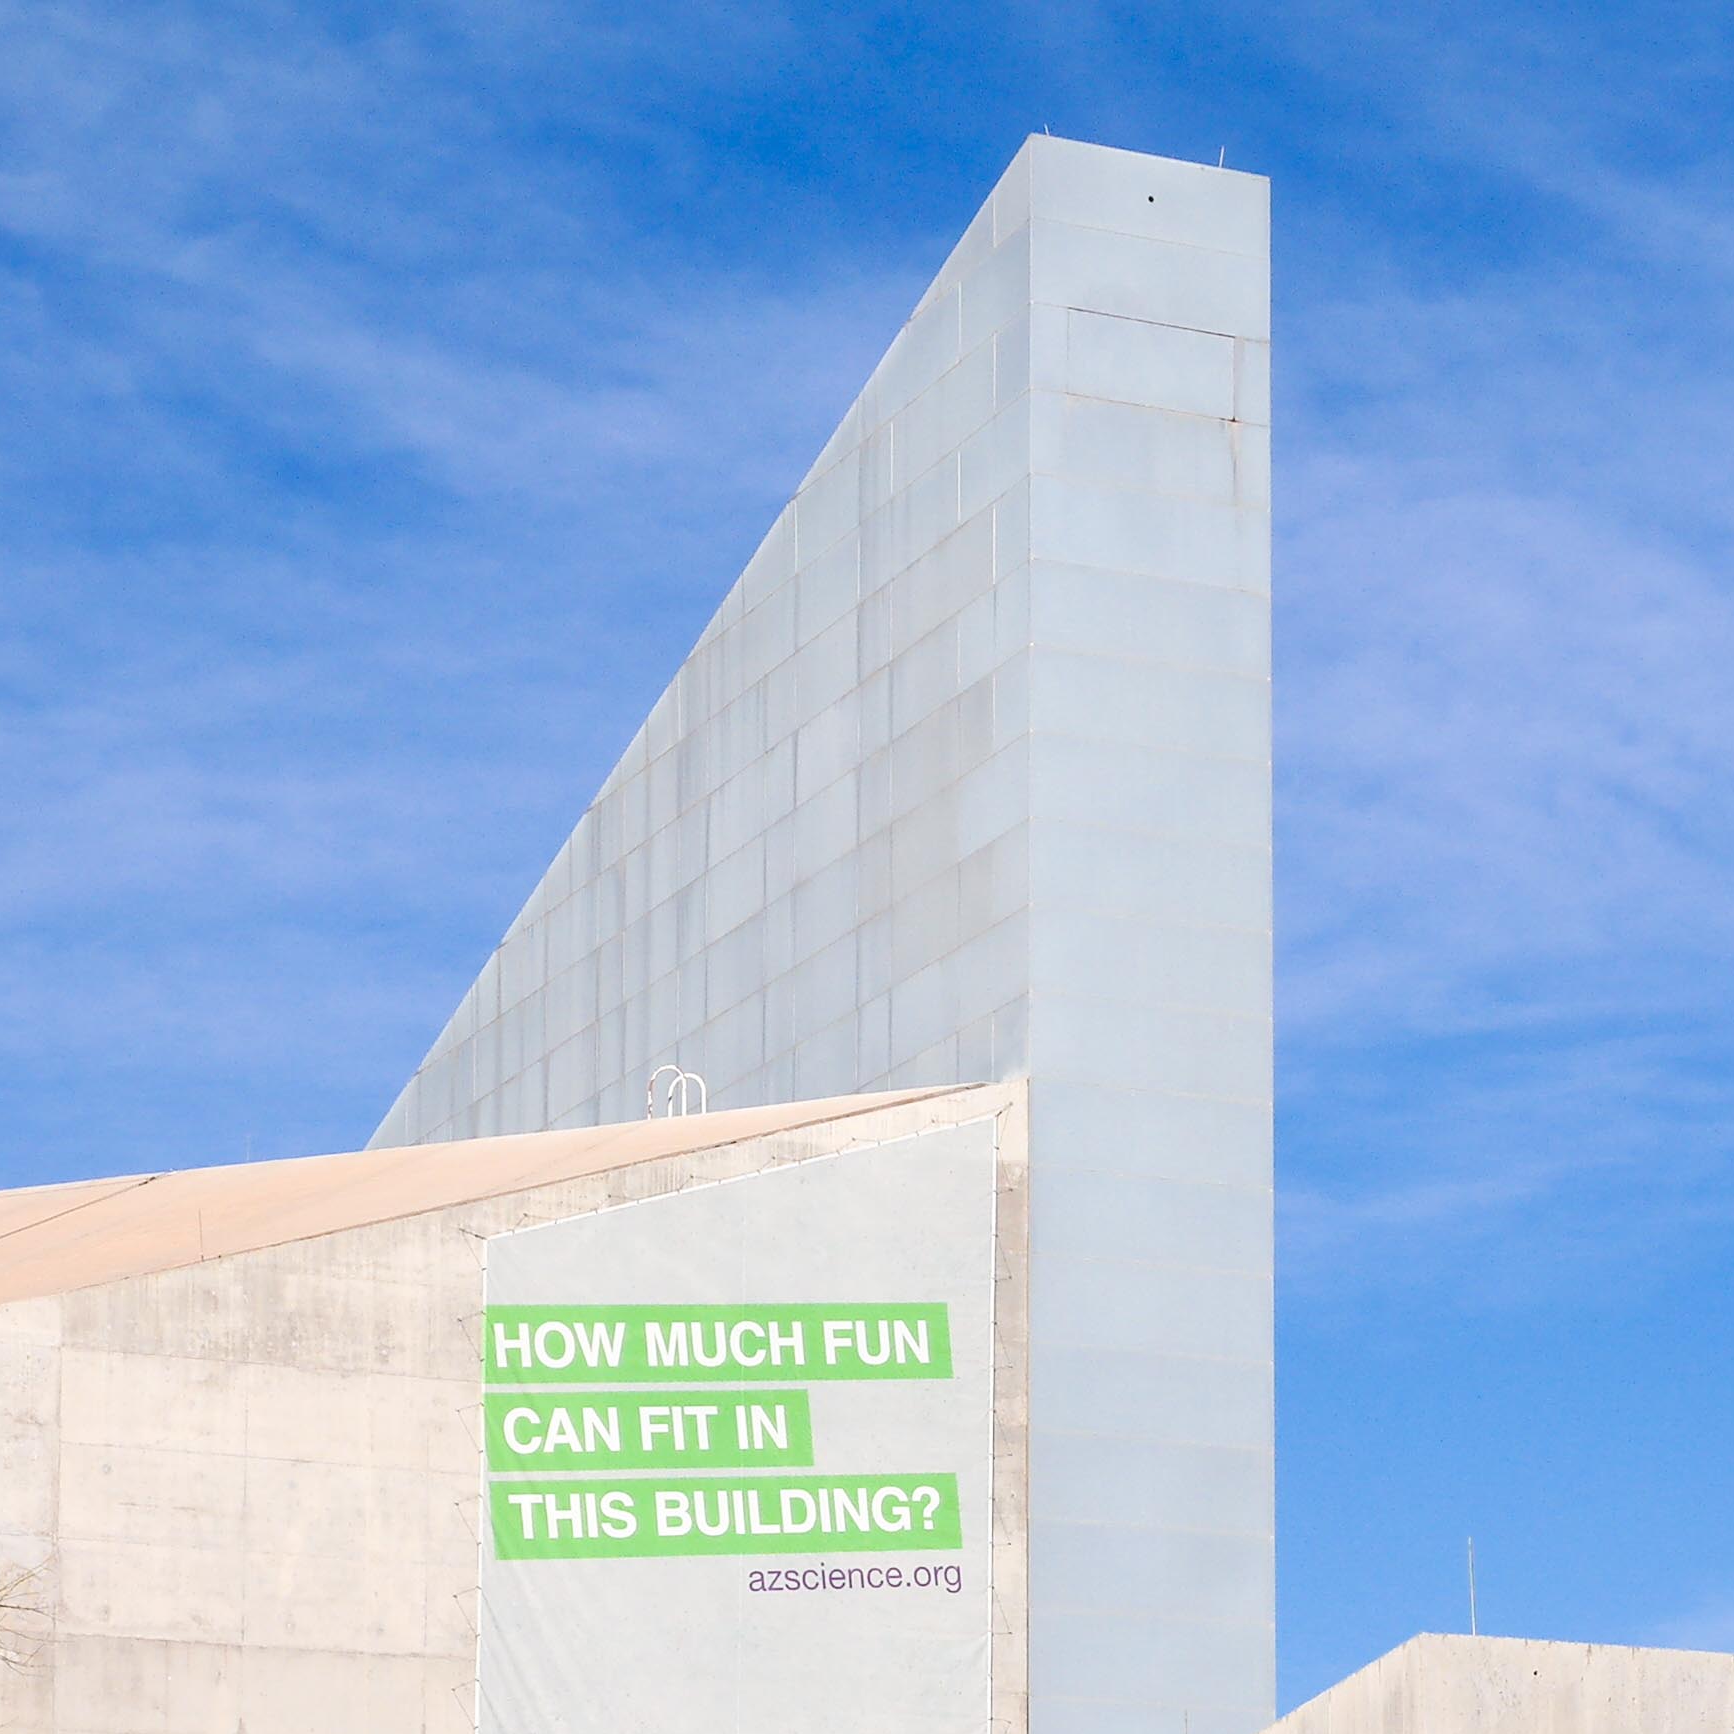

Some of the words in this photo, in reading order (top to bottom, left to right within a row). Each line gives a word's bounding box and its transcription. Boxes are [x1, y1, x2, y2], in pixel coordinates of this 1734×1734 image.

[493, 1320, 626, 1369] HOW
[645, 1320, 806, 1368] MUCH
[822, 1319, 930, 1365] FUN
[503, 1406, 621, 1455] CAN
[638, 1405, 718, 1451] FIT
[735, 1405, 788, 1450] IN
[508, 1491, 637, 1540] THIS
[654, 1486, 941, 1537] BUILDING?
[748, 1562, 963, 1595] azscience.org
